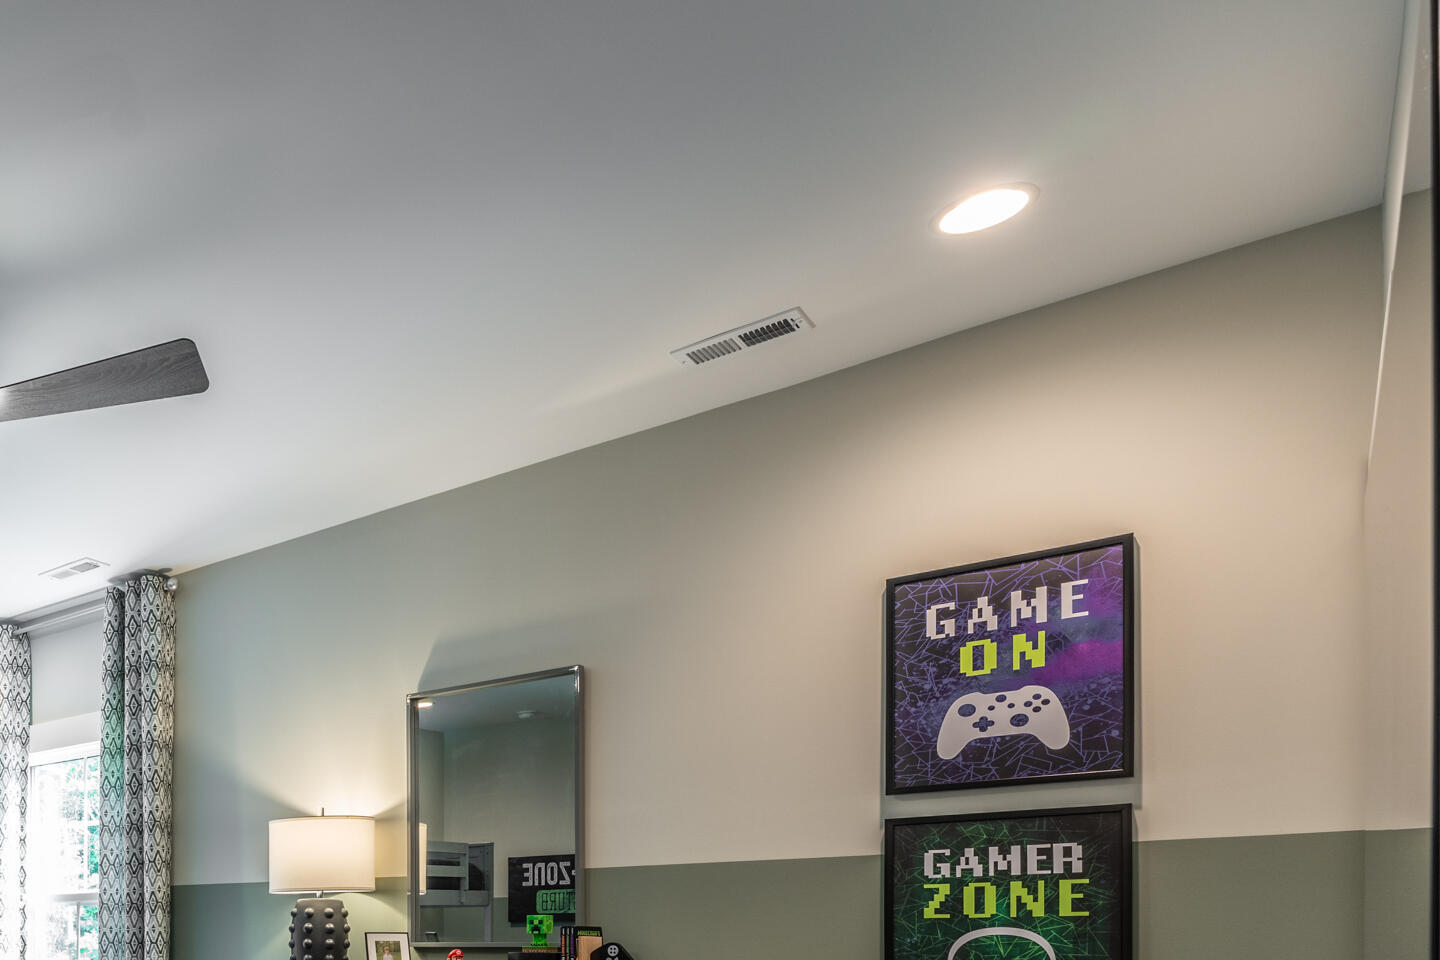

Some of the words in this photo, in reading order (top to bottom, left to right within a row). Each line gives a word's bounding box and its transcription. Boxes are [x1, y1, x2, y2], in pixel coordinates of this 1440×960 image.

[925, 579, 1088, 640] GAME
[960, 631, 1046, 677] ON
[924, 843, 1084, 878] GAMER
[924, 879, 1089, 918] ZONE
